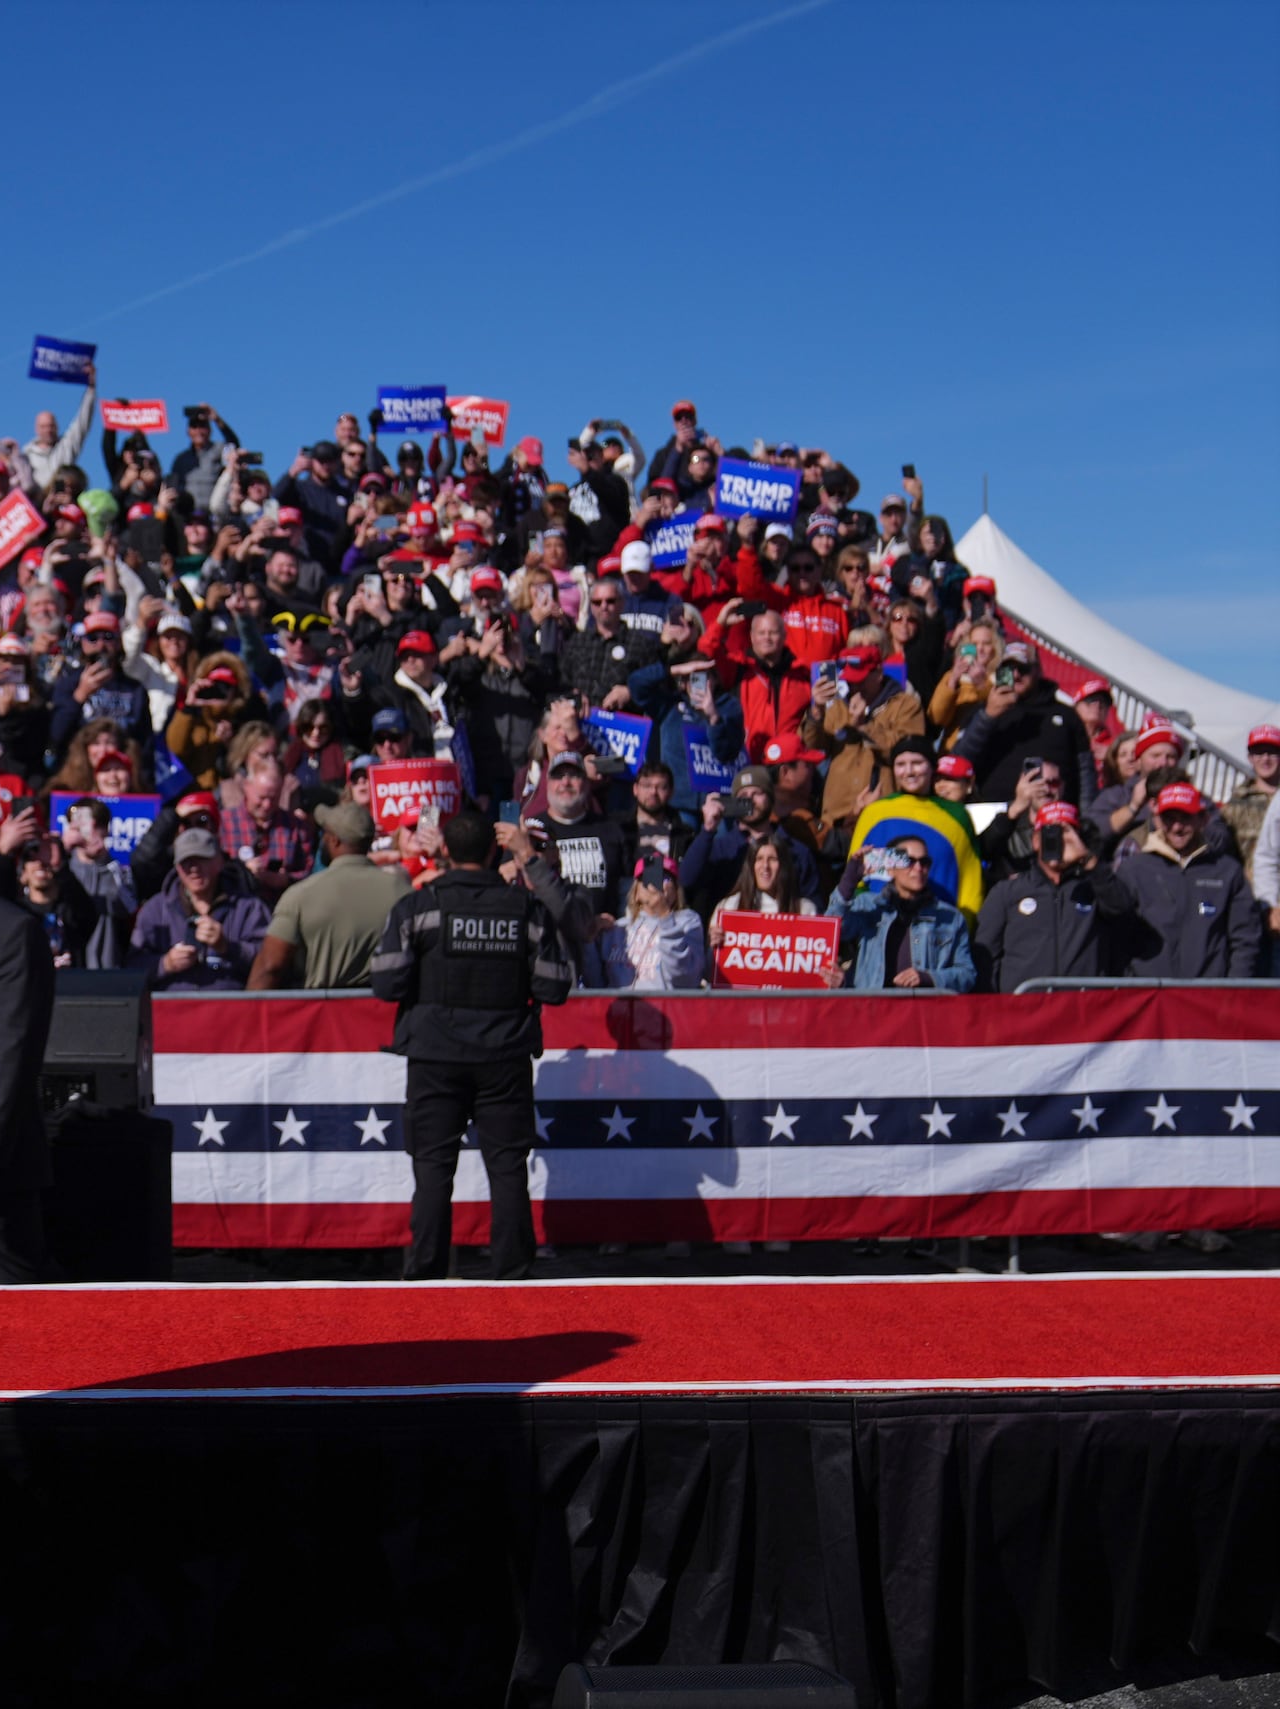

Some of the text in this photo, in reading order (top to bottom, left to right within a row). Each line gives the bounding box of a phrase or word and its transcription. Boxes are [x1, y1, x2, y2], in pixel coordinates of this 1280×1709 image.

[381, 398, 442, 414] TRUMP
[383, 411, 409, 422] WILL
[721, 473, 793, 500] TRUMP
[721, 491, 791, 513] WILL FIX IT
[650, 533, 695, 557] RUM
[693, 761, 721, 777] WILL
[377, 780, 458, 798] DREAM BIG,
[560, 841, 599, 852] ONALD
[452, 918, 519, 940] POLICE
[452, 940, 517, 952] SECRET SERVICE
[724, 931, 832, 956] DREAM BIG,
[723, 948, 822, 973] AGAIN!
